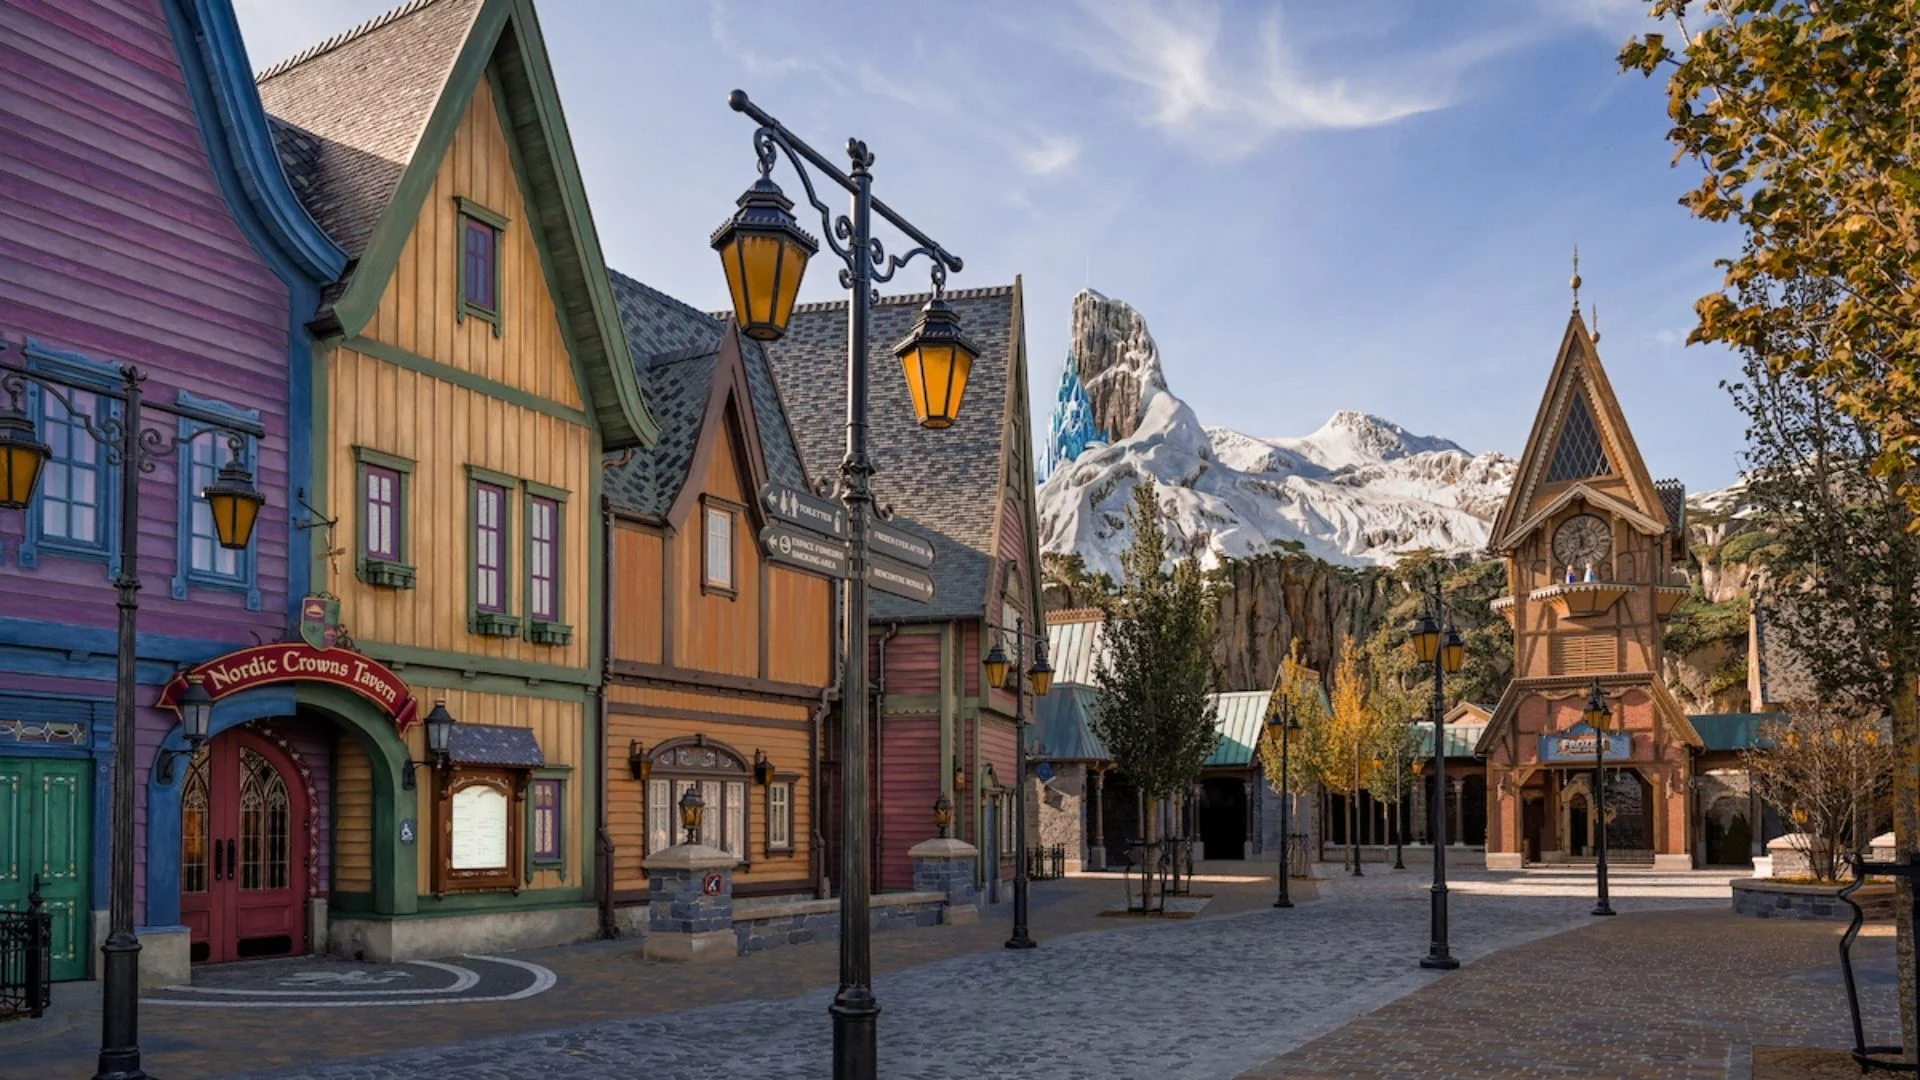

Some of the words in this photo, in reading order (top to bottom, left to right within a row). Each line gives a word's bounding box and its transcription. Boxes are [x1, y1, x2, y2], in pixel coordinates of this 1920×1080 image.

[799, 503, 833, 523] TOILETTES
[208, 655, 277, 690] Nordic
[282, 650, 349, 677] Crowns
[353, 659, 397, 704] Tavern
